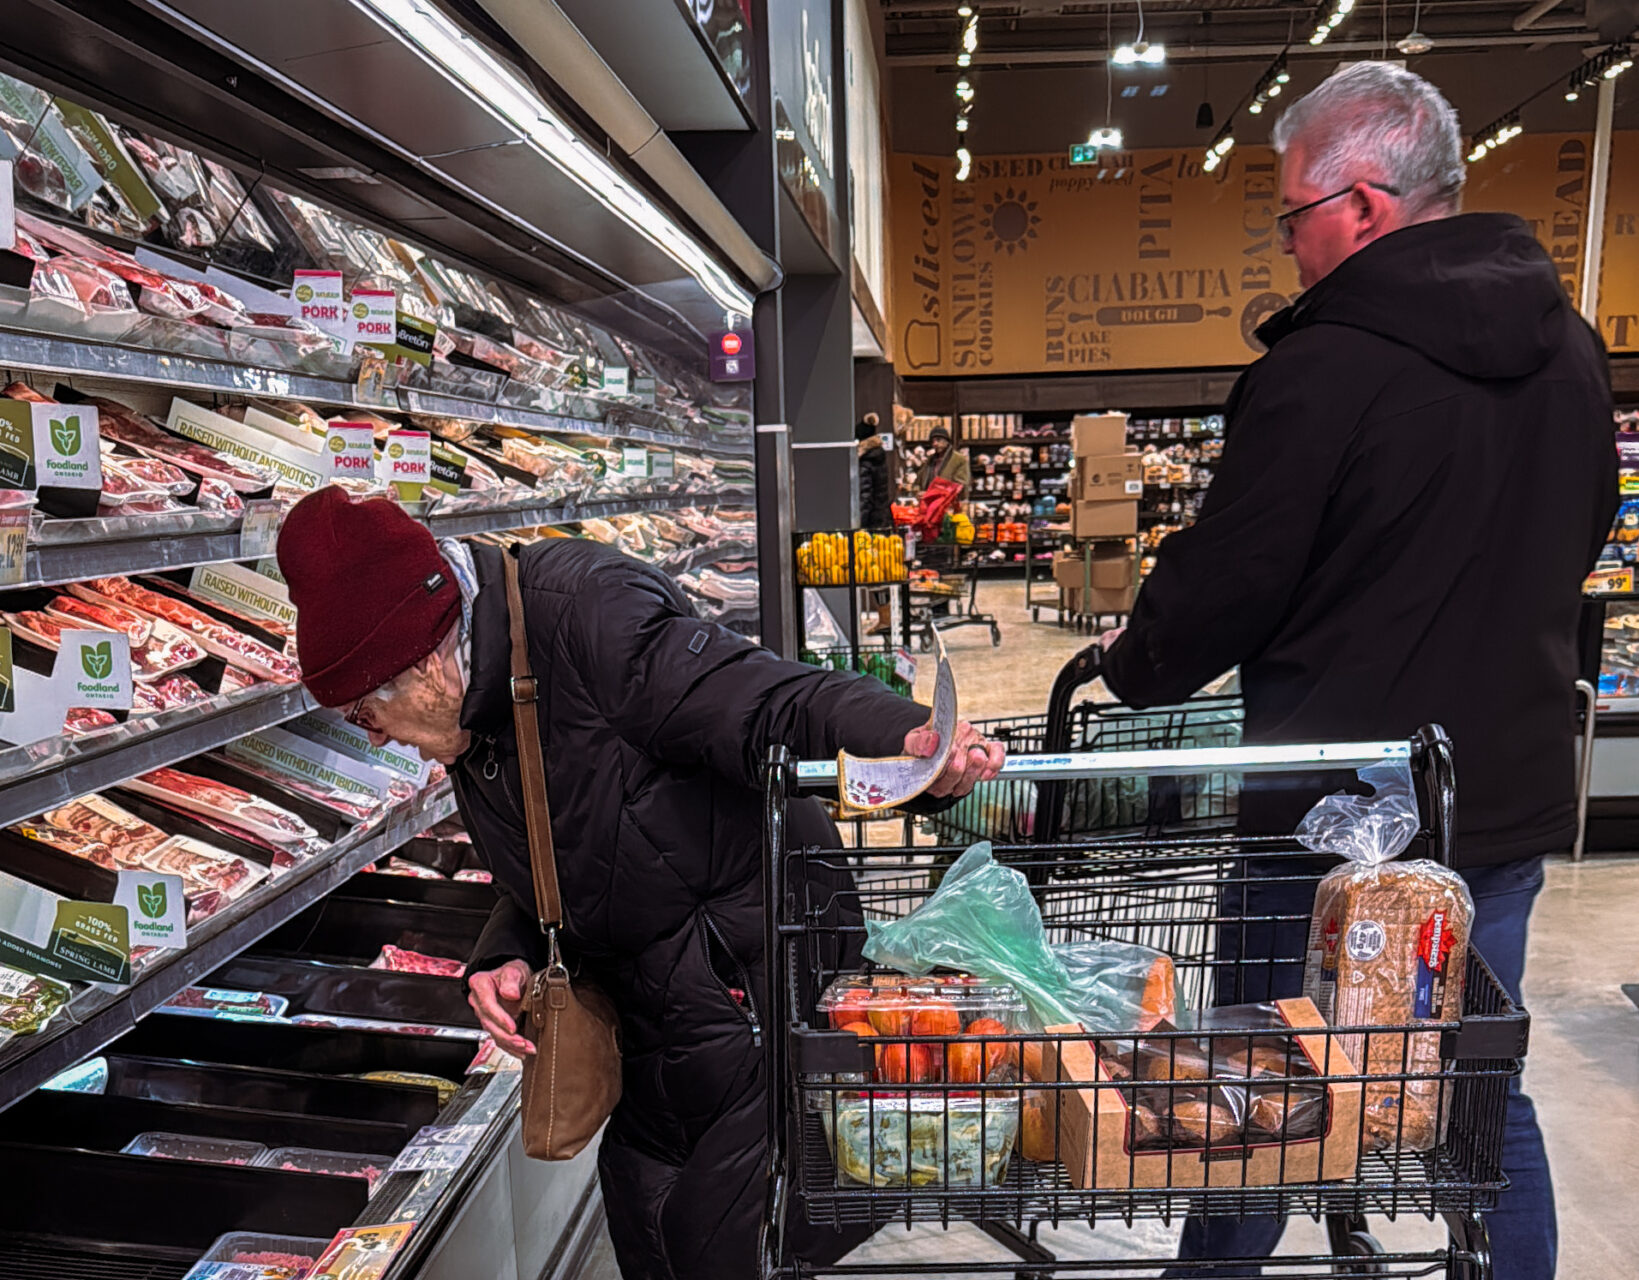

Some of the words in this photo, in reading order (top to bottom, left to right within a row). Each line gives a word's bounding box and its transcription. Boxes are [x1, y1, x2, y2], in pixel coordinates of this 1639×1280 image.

[978, 158, 1043, 178] SEED
[1177, 153, 1235, 184] lof
[1138, 157, 1173, 260] PITA
[912, 162, 939, 318] sliced
[1067, 268, 1232, 304] CIABATTA
[301, 305, 338, 320] PORK
[978, 261, 994, 367] COOKIES
[1045, 275, 1066, 364] BUNS
[1120, 307, 1179, 323] DOUGH
[357, 322, 392, 335] PORK
[397, 328, 429, 350] Breton
[1067, 330, 1113, 346] CAKE
[1067, 346, 1113, 364] PIES
[47, 459, 89, 471] Foodland
[179, 421, 215, 447] RAISED
[215, 436, 258, 464] WITHOUT
[258, 455, 317, 490] ANTIBIOTICS
[334, 456, 370, 470] PORK
[393, 461, 426, 474] PORK
[203, 572, 237, 597] RAISED
[237, 586, 280, 614] WITHOUT
[76, 681, 120, 694] Foodland
[301, 713, 330, 734] RAISED
[329, 723, 368, 752] WITHOUT
[368, 744, 420, 775] ANTIBIOTICS
[241, 737, 276, 758] RAISED
[275, 749, 319, 777] WITHOUT
[318, 768, 374, 796] ANTIBIOTICS
[75, 919, 101, 937] GRASS
[103, 932, 119, 944] FED
[87, 915, 112, 933] 100%
[133, 920, 174, 933] Foodland
[2, 940, 26, 955] ADDED
[26, 949, 63, 971] HORMONES
[60, 946, 91, 966] SPRING
[93, 961, 116, 976] LAMB
